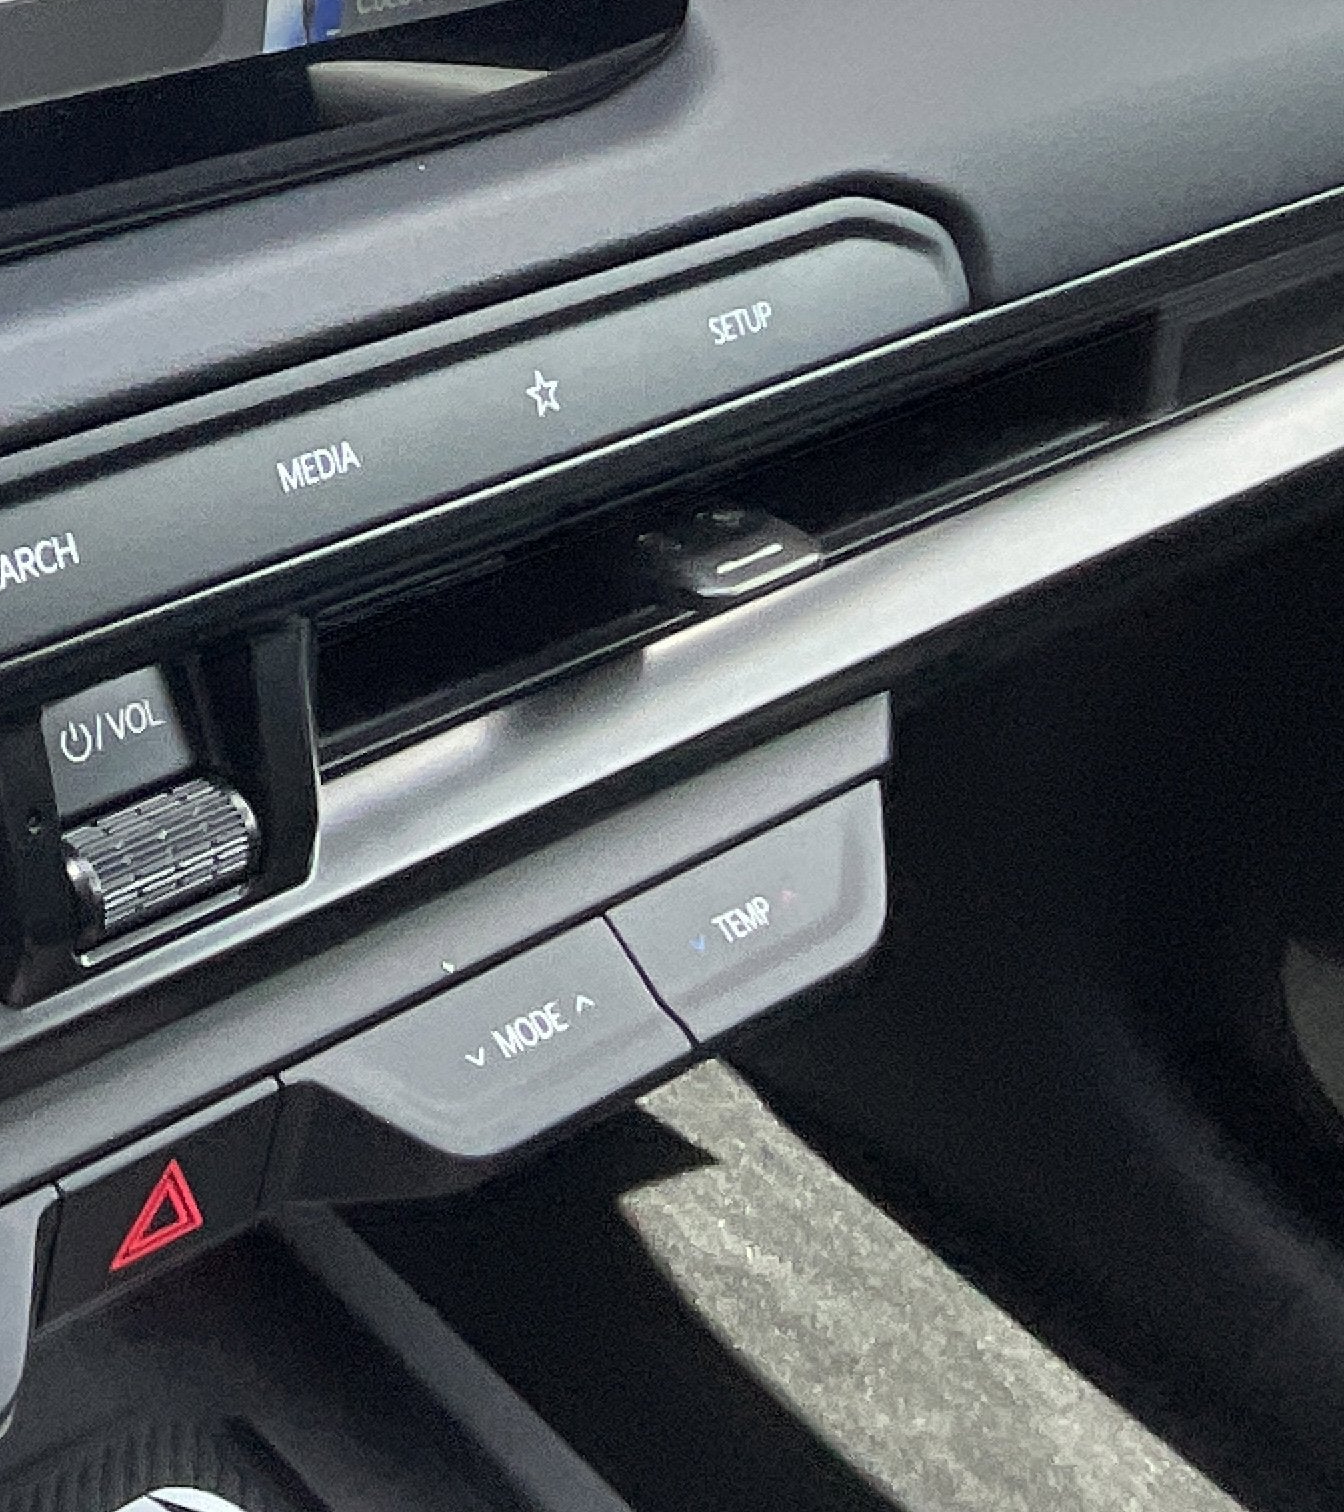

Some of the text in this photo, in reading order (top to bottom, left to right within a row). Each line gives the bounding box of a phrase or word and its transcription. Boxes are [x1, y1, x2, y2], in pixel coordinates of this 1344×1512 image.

[707, 301, 773, 347] SETUP
[276, 439, 362, 494] MEDIA
[711, 896, 771, 943] TEMP
[491, 998, 570, 1058] MODE
